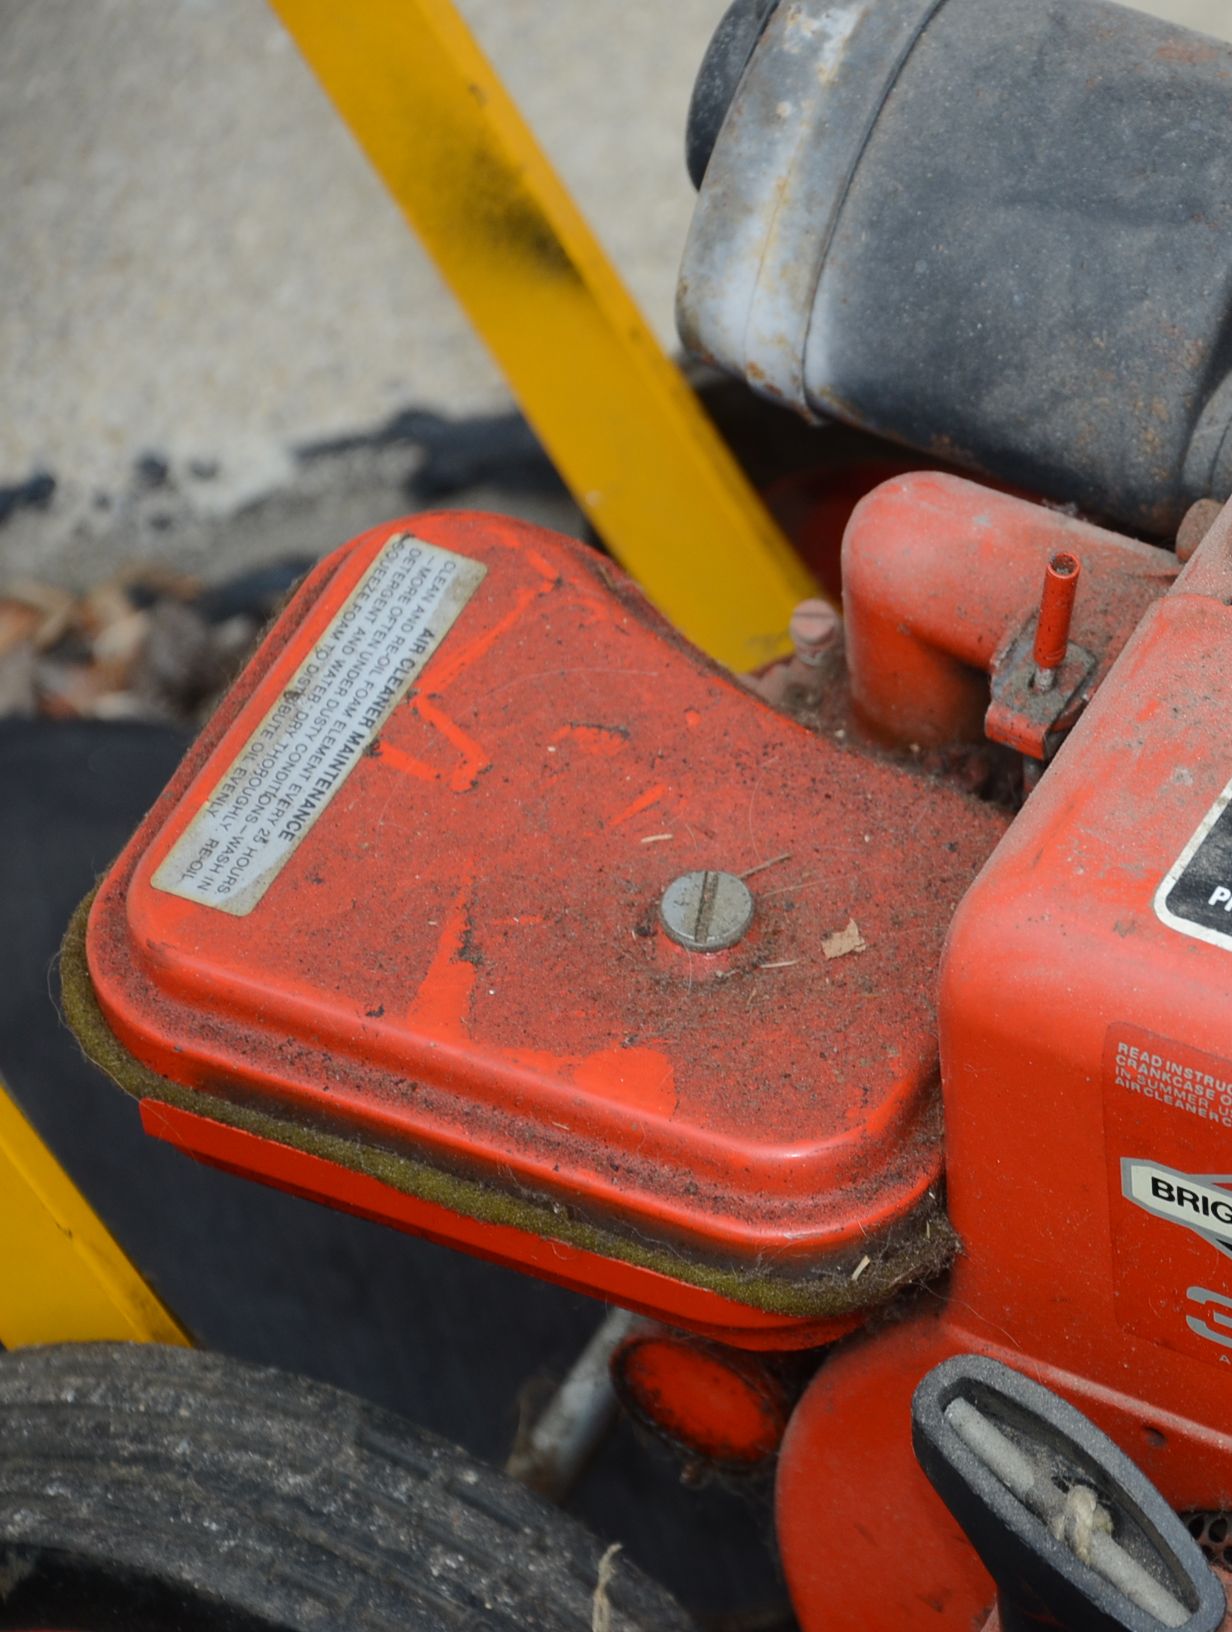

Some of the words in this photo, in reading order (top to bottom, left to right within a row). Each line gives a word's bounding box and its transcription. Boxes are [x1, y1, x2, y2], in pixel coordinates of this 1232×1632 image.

[364, 547, 423, 623] DETERGENT
[421, 560, 458, 603] CLEAN
[330, 602, 363, 640] FOAM
[340, 627, 368, 656] AND
[367, 606, 405, 650] OFTEN
[400, 606, 426, 635] AND
[314, 639, 336, 662] TO
[369, 635, 406, 679] RE-OIL
[409, 629, 436, 656] AIR
[334, 650, 374, 698] UNDER
[358, 657, 416, 730] CLEANER
[303, 698, 340, 741] DUSTY
[342, 680, 375, 718] FOAM
[282, 709, 310, 738] DRY
[242, 741, 265, 766] OIL
[298, 720, 347, 781] ELEMENT
[266, 783, 303, 826] EVERY
[278, 730, 366, 843] MAINTENANCE
[180, 837, 220, 883] RE-OIL
[196, 876, 215, 893] IN
[1116, 1066, 1129, 1080] IN
[1119, 1042, 1160, 1069] READ
[1117, 1054, 1213, 1101] CRANKCASE
[1116, 1077, 1139, 1094] AIR
[1144, 1087, 1217, 1124] CLEANER
